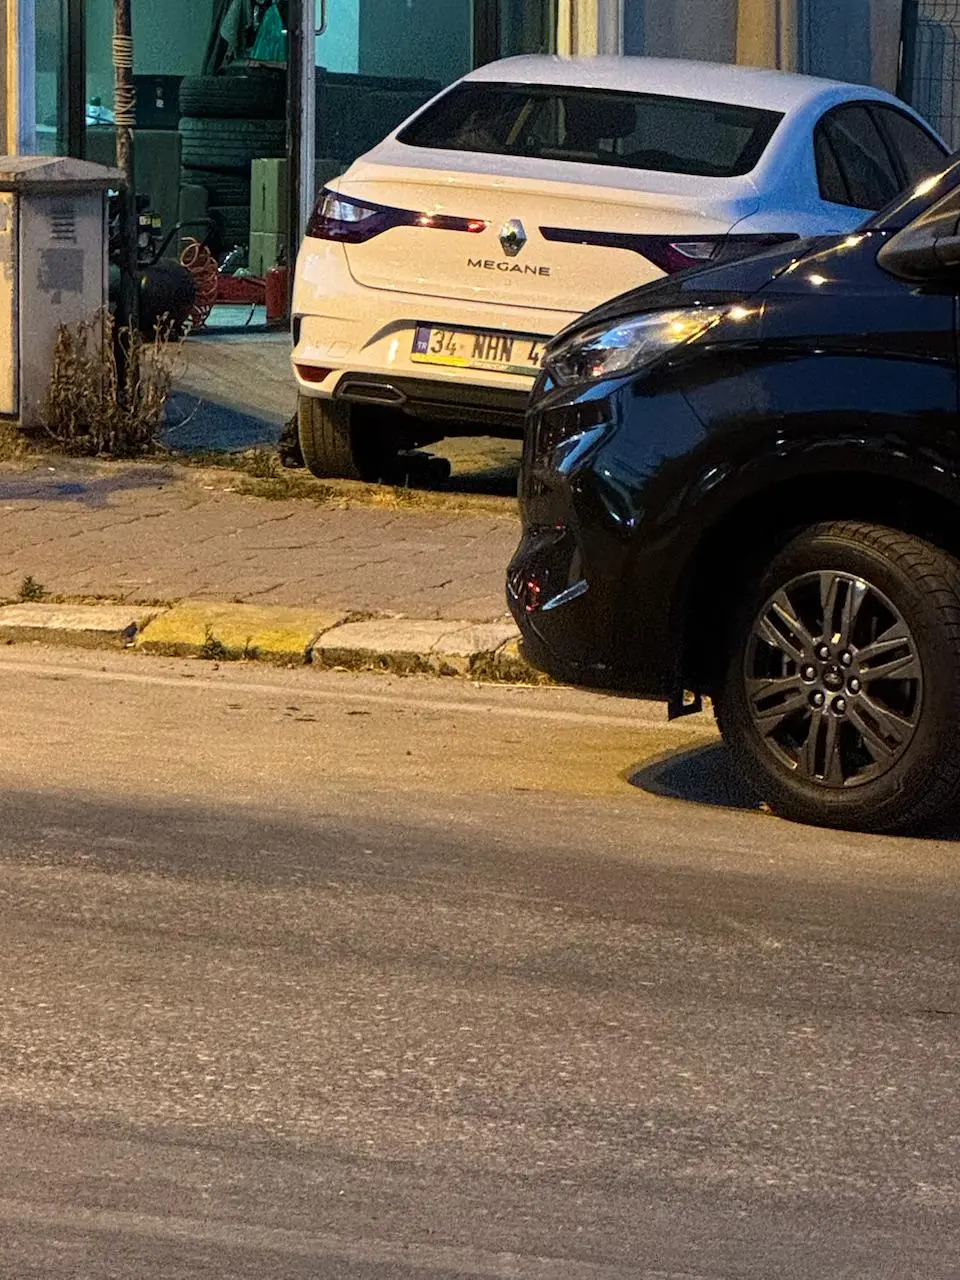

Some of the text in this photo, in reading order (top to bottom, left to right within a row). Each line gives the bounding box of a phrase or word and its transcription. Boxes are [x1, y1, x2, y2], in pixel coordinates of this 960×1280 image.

[467, 258, 551, 277] MEGANE
[417, 341, 428, 350] TR
[431, 330, 457, 356] 34
[472, 334, 514, 363] NHN
